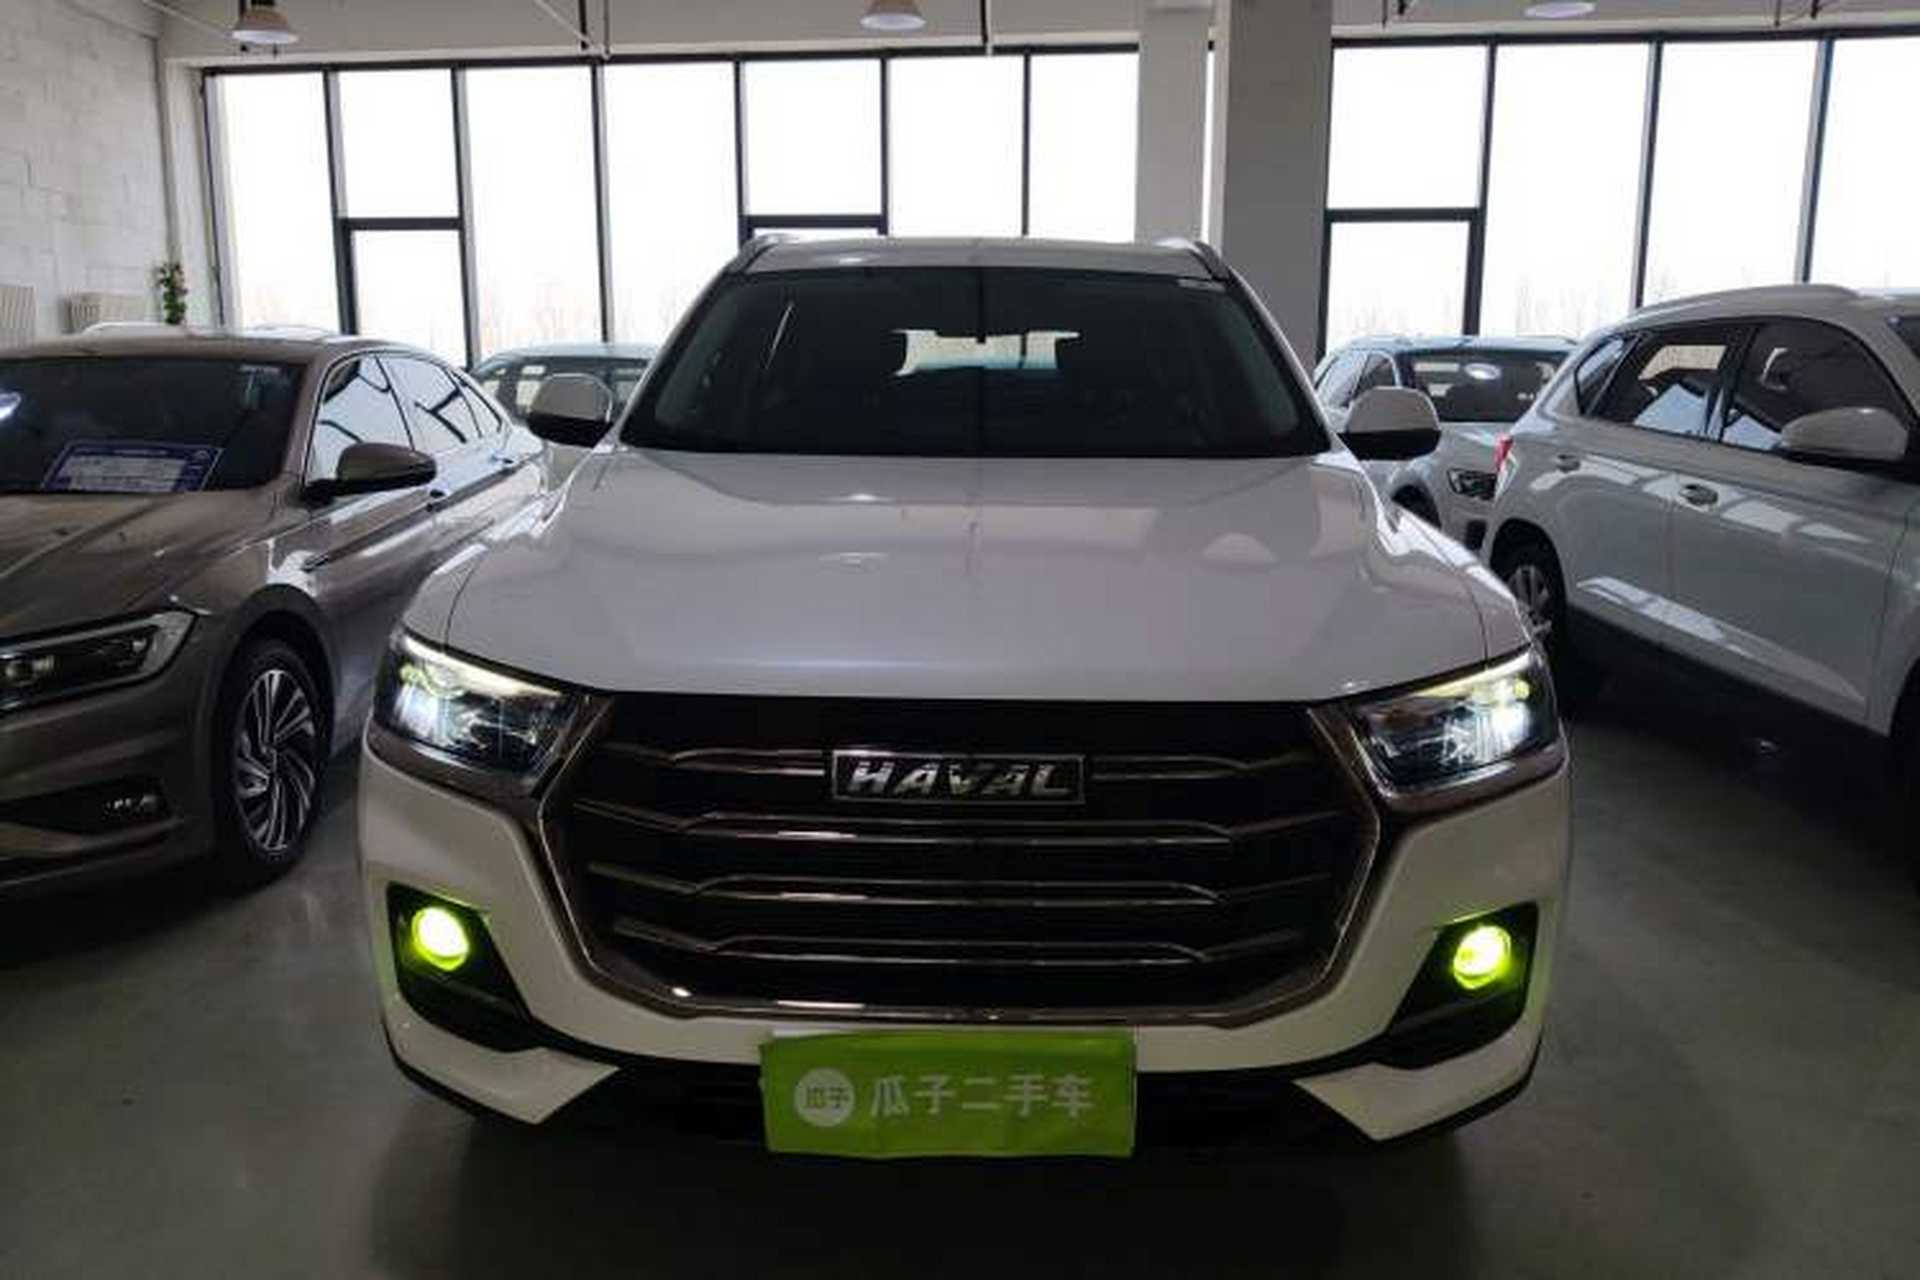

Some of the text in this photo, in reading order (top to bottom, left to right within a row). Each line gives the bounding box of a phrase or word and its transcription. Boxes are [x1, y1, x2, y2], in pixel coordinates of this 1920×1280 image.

[849, 761, 1070, 795] HAVAL
[870, 1073, 1094, 1117] 瓜子二手车
